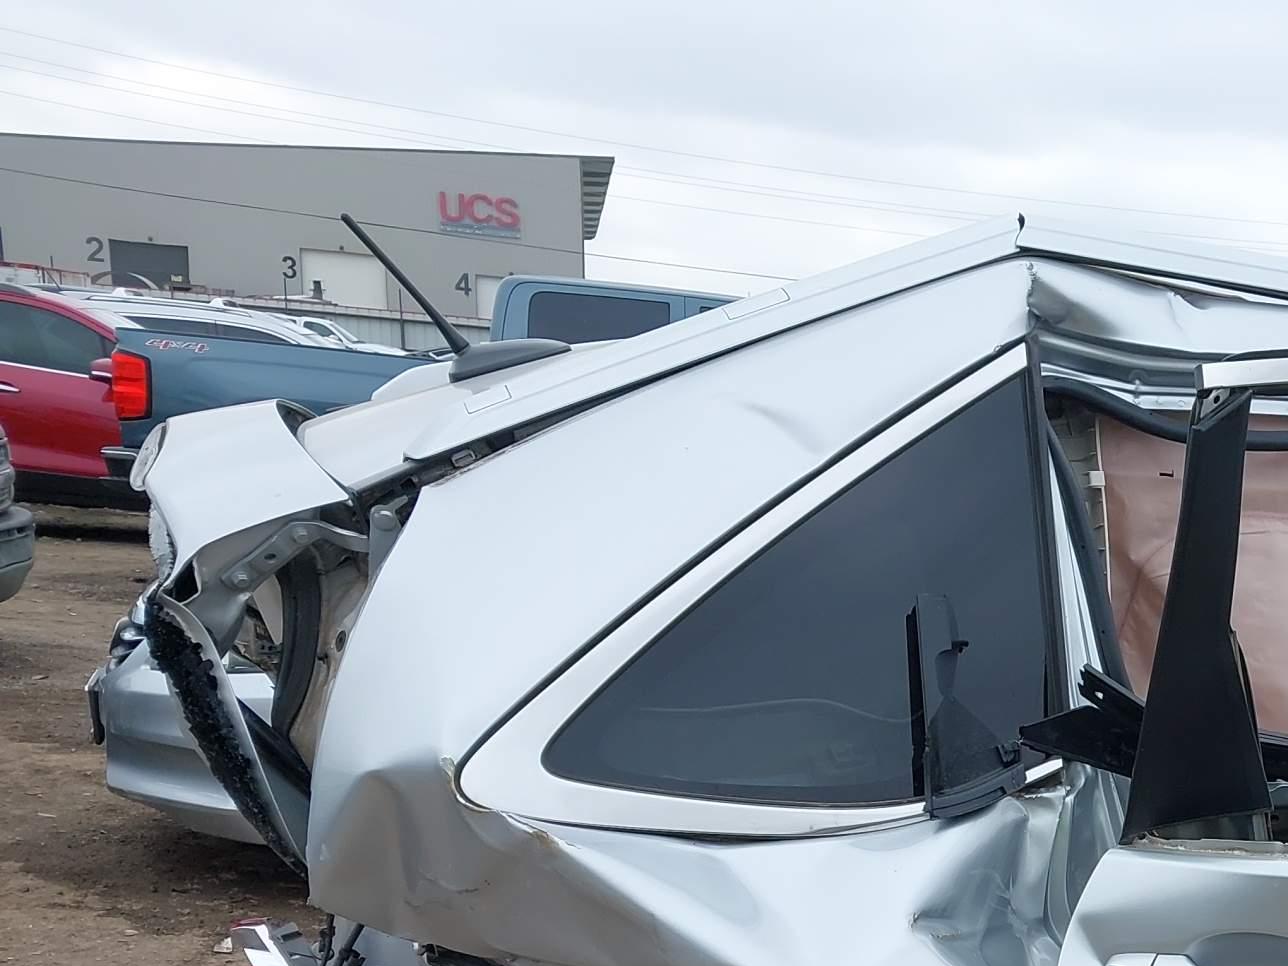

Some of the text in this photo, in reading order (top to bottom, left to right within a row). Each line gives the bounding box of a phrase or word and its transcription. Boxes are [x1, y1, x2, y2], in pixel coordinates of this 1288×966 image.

[439, 191, 520, 228] UCS
[85, 236, 105, 262] 2
[281, 256, 297, 279] 3
[454, 272, 472, 297] 4
